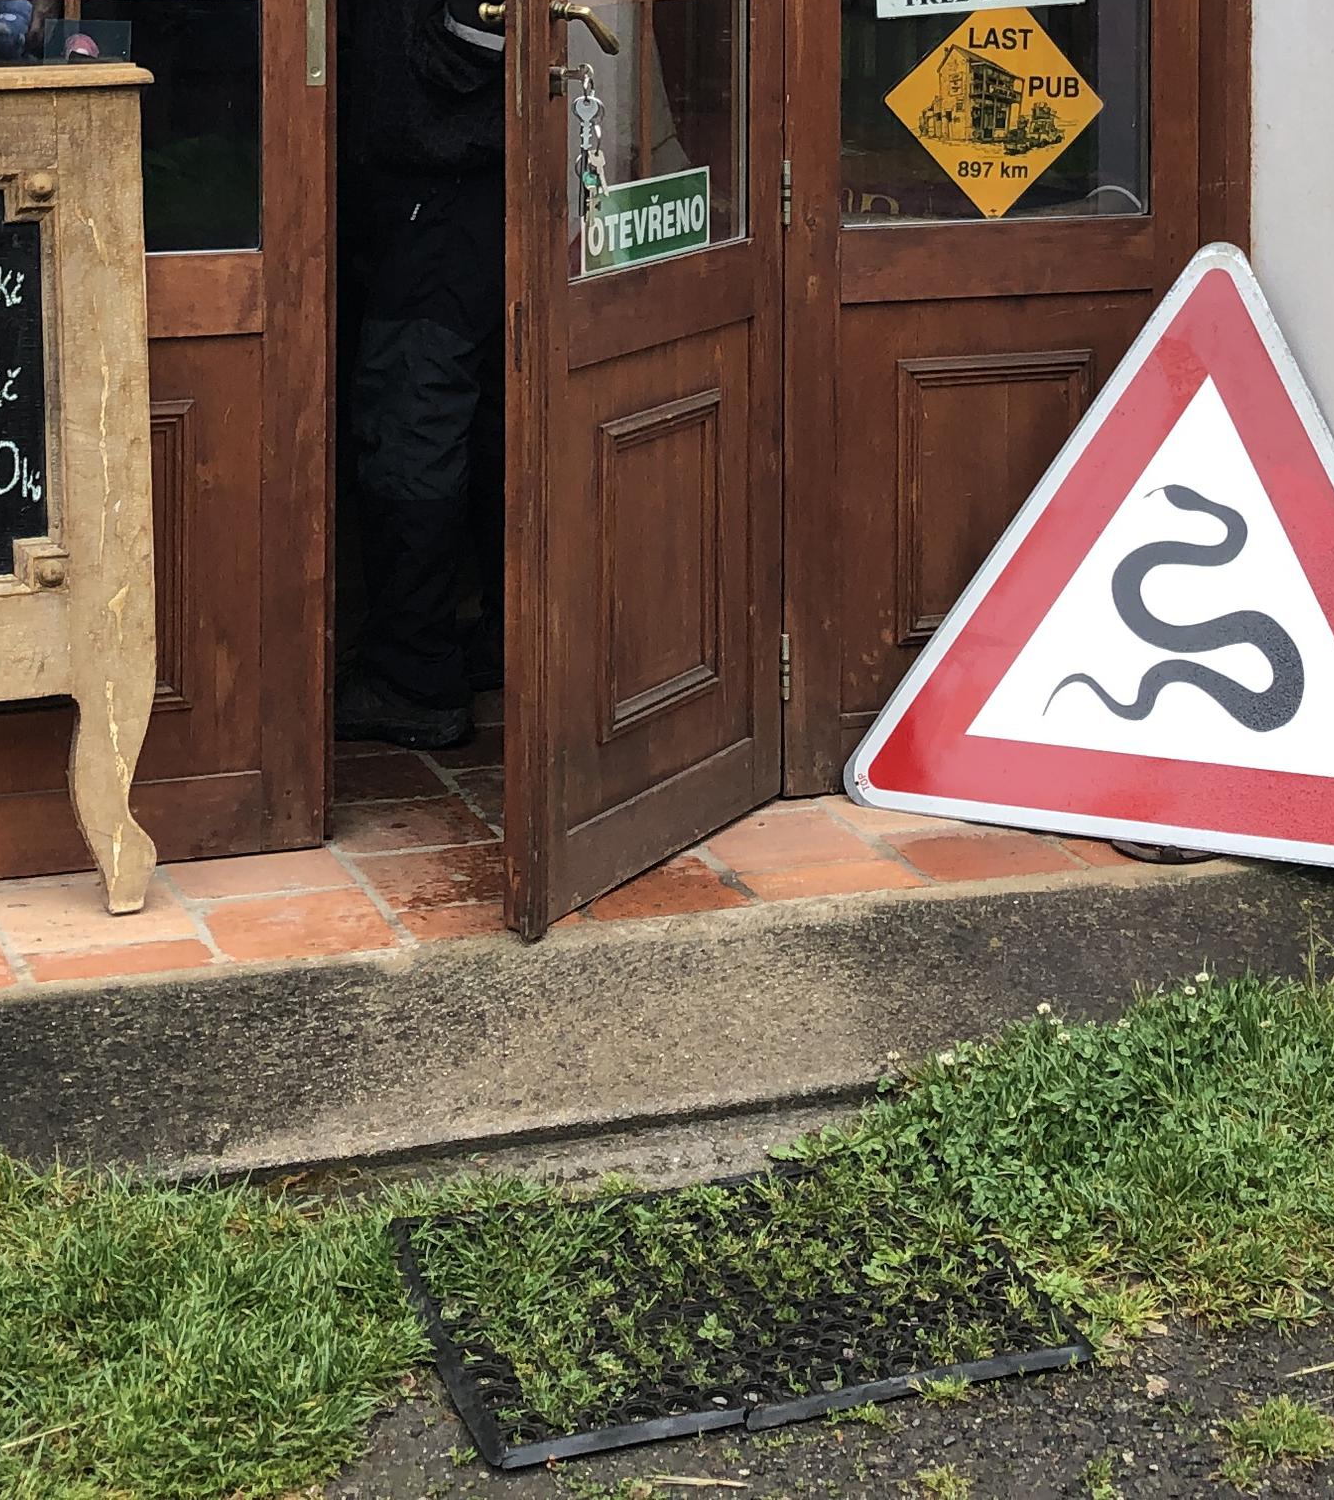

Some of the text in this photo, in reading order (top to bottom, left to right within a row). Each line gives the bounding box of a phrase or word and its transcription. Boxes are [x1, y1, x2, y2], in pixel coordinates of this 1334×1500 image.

[968, 27, 1034, 51] LAST
[1028, 76, 1080, 99] PUB
[957, 160, 1028, 179] 897 km
[588, 194, 705, 257] OTEVŘENO
